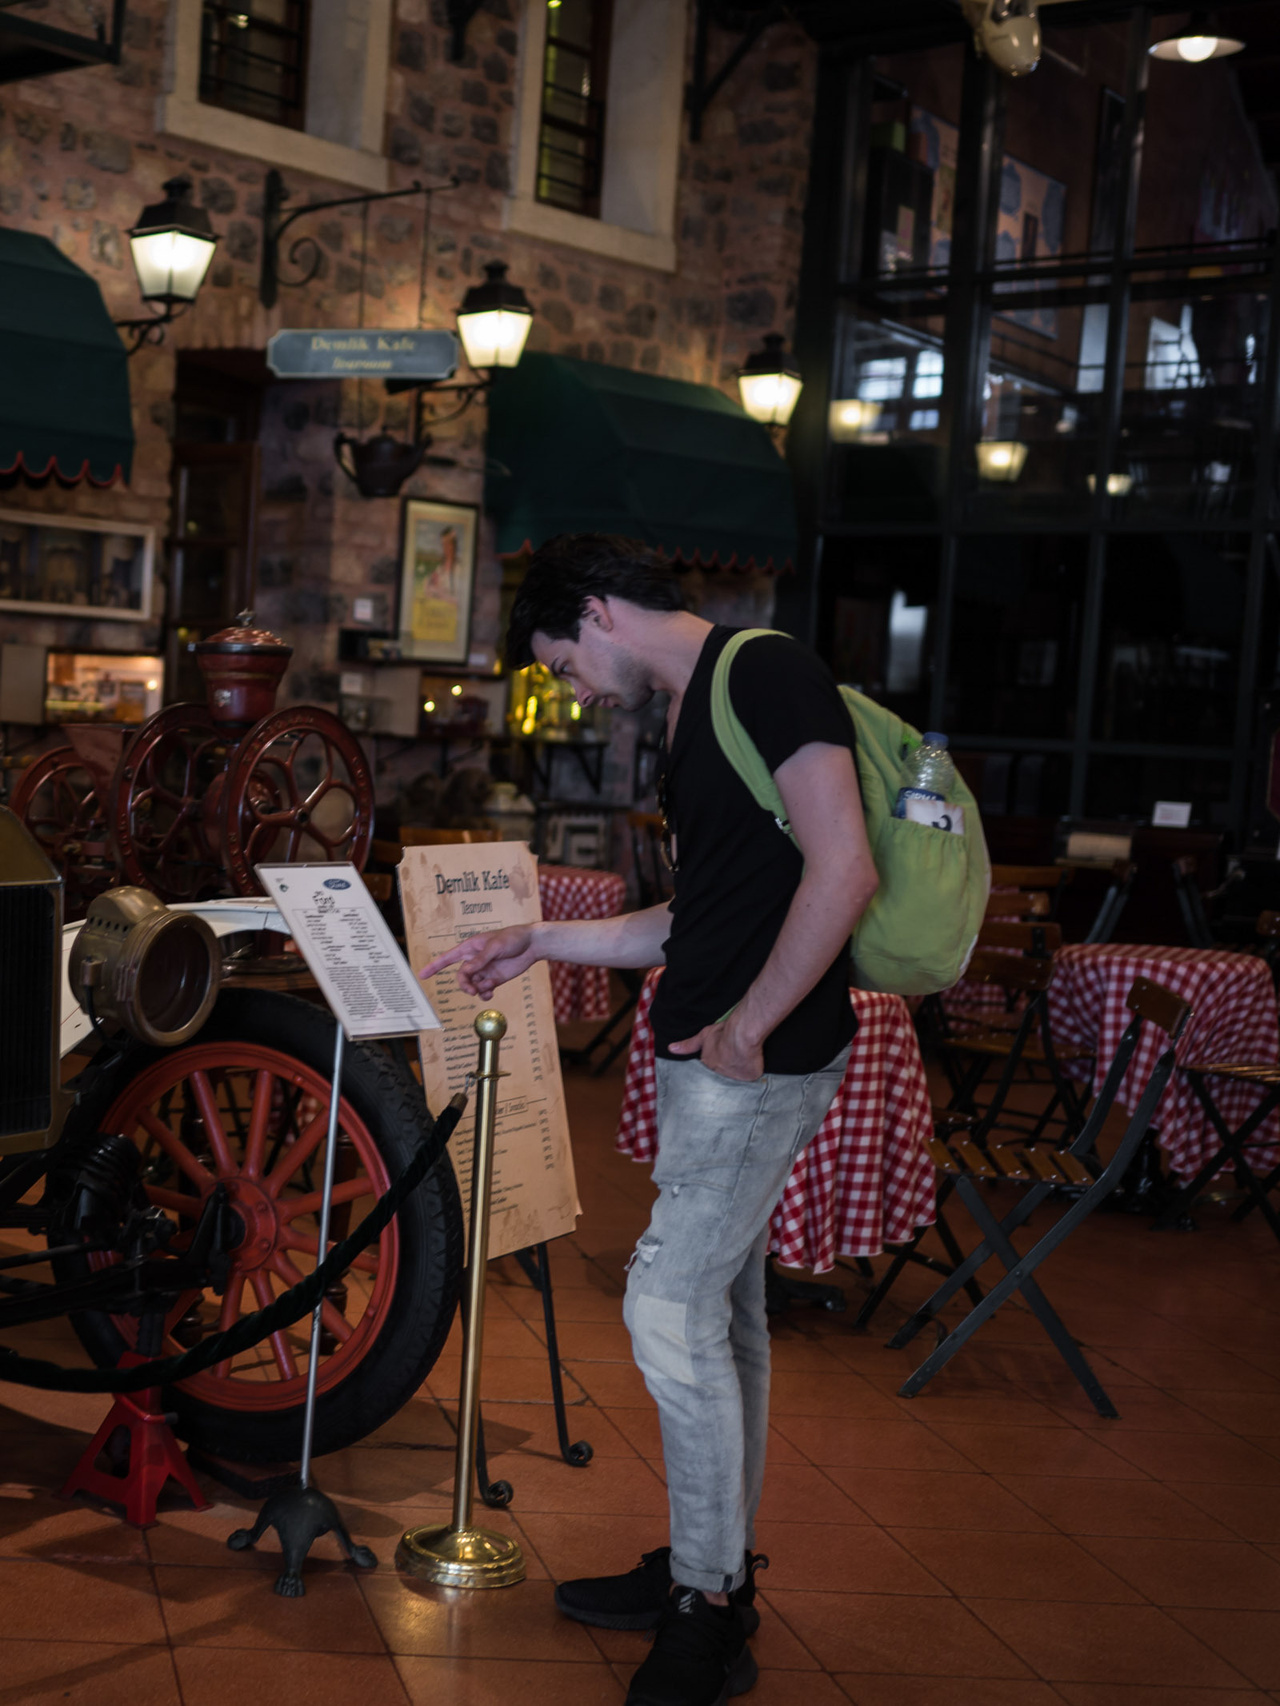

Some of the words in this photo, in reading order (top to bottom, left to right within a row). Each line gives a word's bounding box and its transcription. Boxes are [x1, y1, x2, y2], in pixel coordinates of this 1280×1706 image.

[312, 338, 368, 350] Demlik
[378, 338, 414, 350] Kafe
[435, 871, 480, 894] Demlik
[482, 869, 510, 890] Kafe
[460, 901, 493, 915] Tearoom
